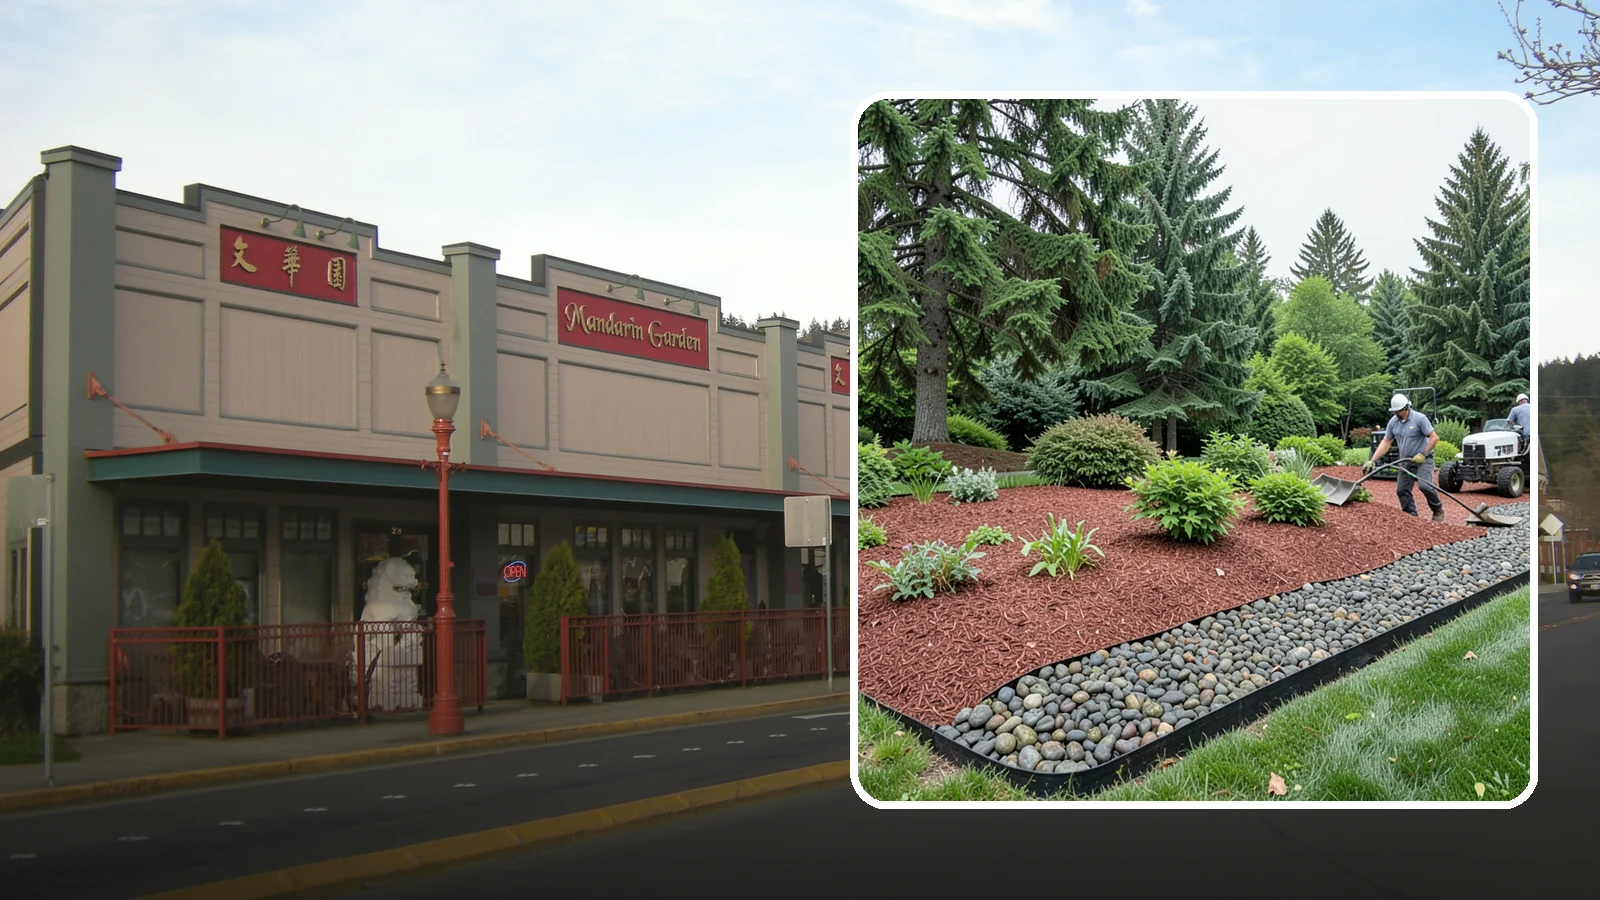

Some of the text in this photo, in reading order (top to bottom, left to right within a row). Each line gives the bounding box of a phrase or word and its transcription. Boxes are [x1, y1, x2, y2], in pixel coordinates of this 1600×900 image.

[231, 235, 346, 291] 文華園
[564, 302, 701, 352] Mandarin Garden
[503, 565, 527, 578] OPEN
